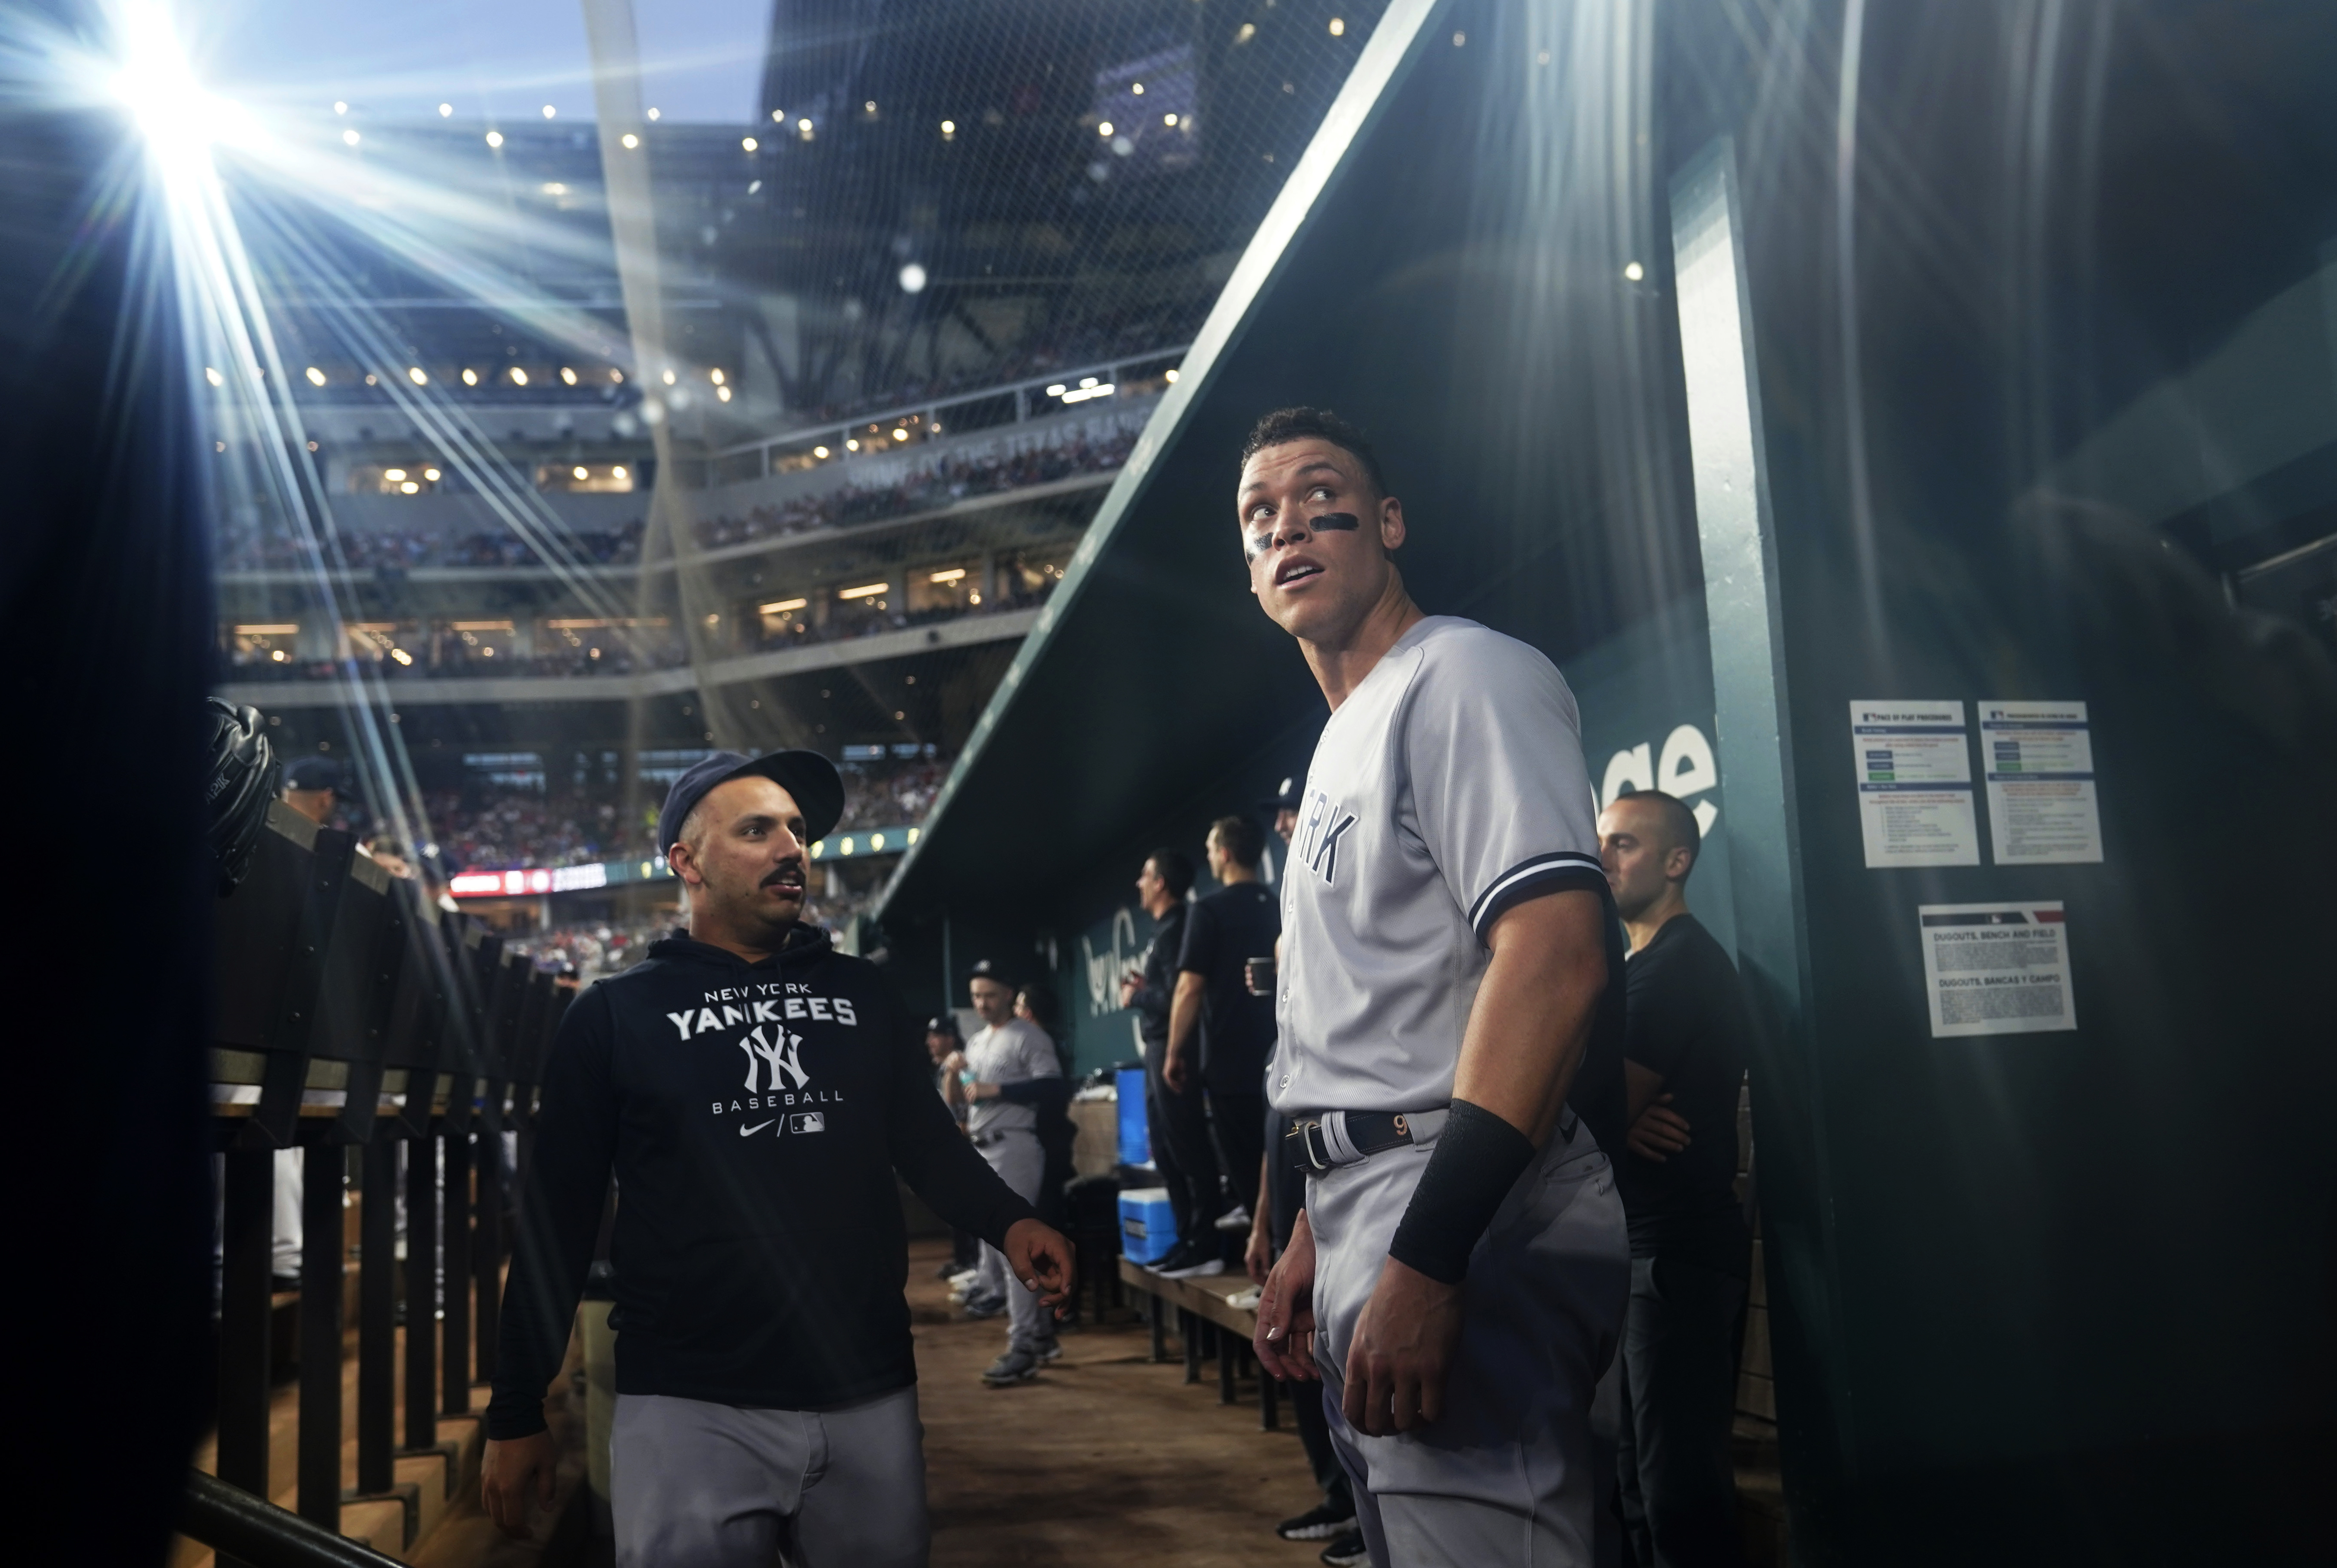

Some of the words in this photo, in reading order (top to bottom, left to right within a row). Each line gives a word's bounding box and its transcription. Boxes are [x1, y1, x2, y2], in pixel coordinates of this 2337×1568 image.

[204, 772, 231, 805] A2K
[1297, 787, 1359, 887] RK
[1981, 931, 2011, 940] BENCH
[2012, 929, 2031, 938] AND
[2032, 929, 2056, 938] FIELD
[1985, 976, 2019, 986] BANCAS
[2021, 975, 2026, 983] Y
[2029, 974, 2060, 983] CAMPO
[704, 986, 748, 1003] NEW
[756, 983, 812, 996] YORK
[666, 997, 858, 1041] YANKEES
[712, 1090, 844, 1114] BASEBALL
[1393, 1115, 1408, 1136] 9
